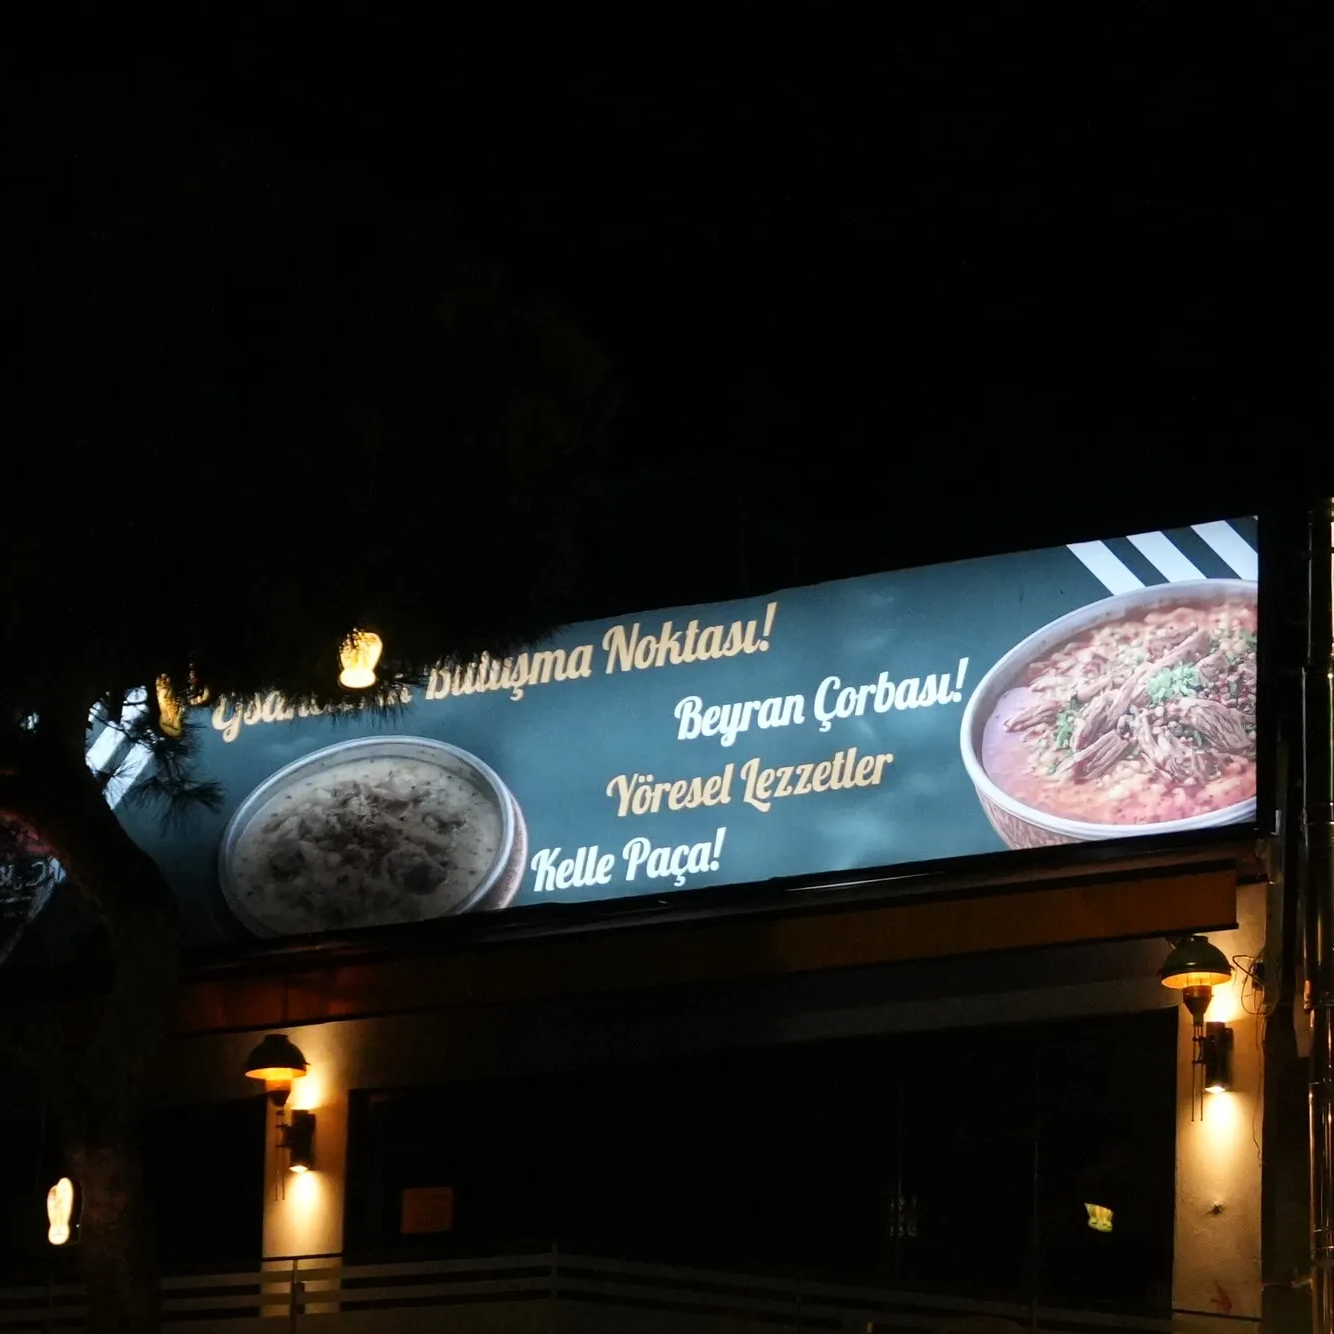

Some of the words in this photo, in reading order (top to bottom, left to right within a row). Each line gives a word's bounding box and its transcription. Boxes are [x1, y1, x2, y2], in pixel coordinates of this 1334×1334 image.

[602, 601, 777, 675] Noktası!
[673, 694, 805, 748] Beyran
[813, 656, 970, 733] Çorbası!
[606, 763, 734, 817] Yöresel
[739, 746, 894, 813] Lezzetler
[530, 845, 616, 892] Kelle
[622, 826, 727, 887] Paça!
